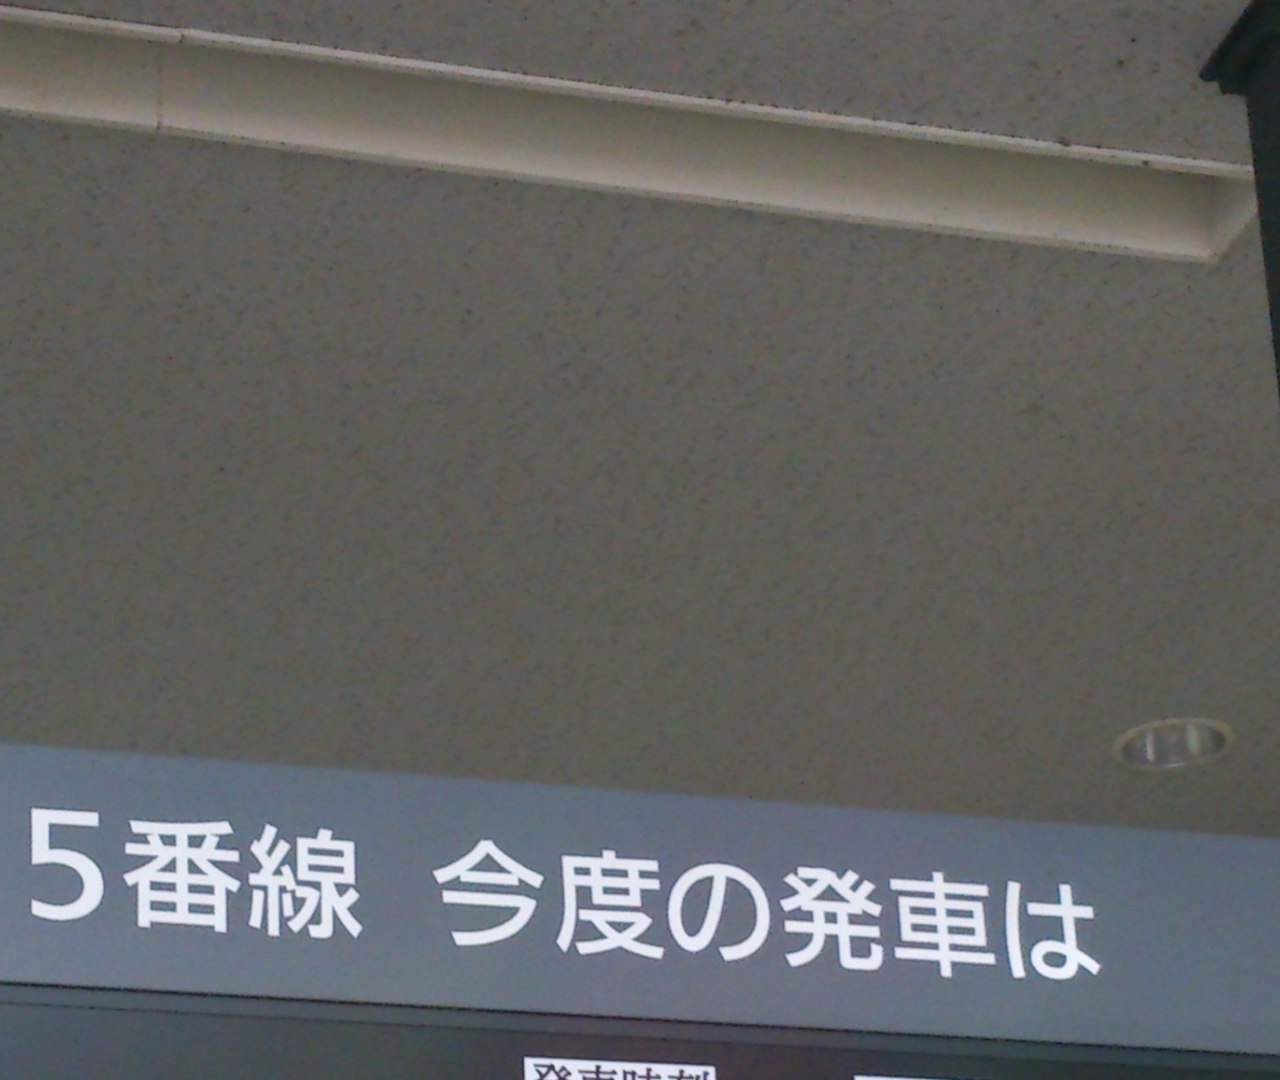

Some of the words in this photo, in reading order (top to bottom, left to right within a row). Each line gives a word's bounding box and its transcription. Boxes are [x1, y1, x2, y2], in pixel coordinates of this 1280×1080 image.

[432, 838, 1102, 980] 今度の発車は
